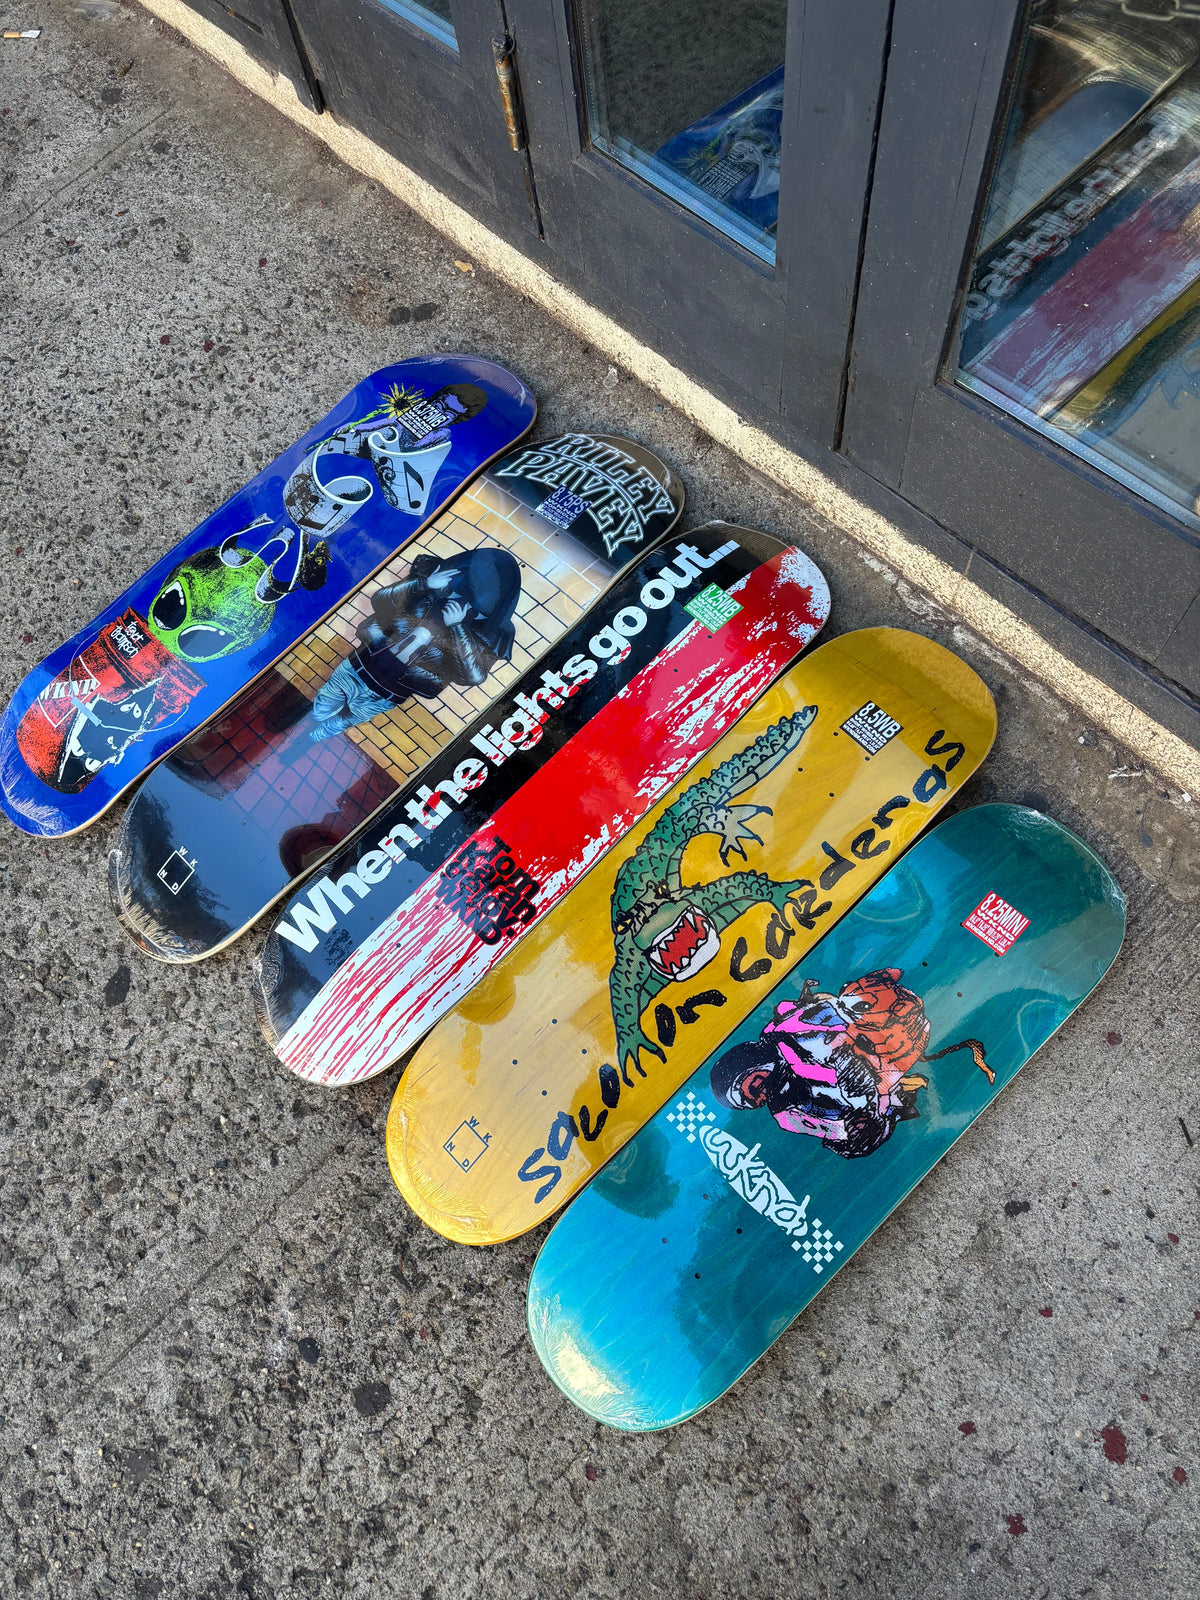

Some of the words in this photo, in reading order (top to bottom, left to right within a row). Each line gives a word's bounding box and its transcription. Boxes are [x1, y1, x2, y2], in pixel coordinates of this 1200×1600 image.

[408, 409, 433, 431] WKND
[540, 432, 675, 525] RILEY
[495, 450, 644, 558] PAVEY
[547, 497, 577, 519] WKND
[551, 486, 589, 514] 8.75PS
[697, 596, 728, 622] WKND
[701, 584, 741, 618] 8.25WB
[854, 714, 887, 744] WKND
[859, 702, 901, 739] 8.5WB
[274, 823, 423, 954] When
[403, 758, 489, 831] the
[470, 654, 599, 767] lights
[588, 606, 648, 666] go
[485, 835, 540, 901] Tom
[977, 909, 1015, 941] WKND
[980, 893, 1029, 937] 8.25MINI
